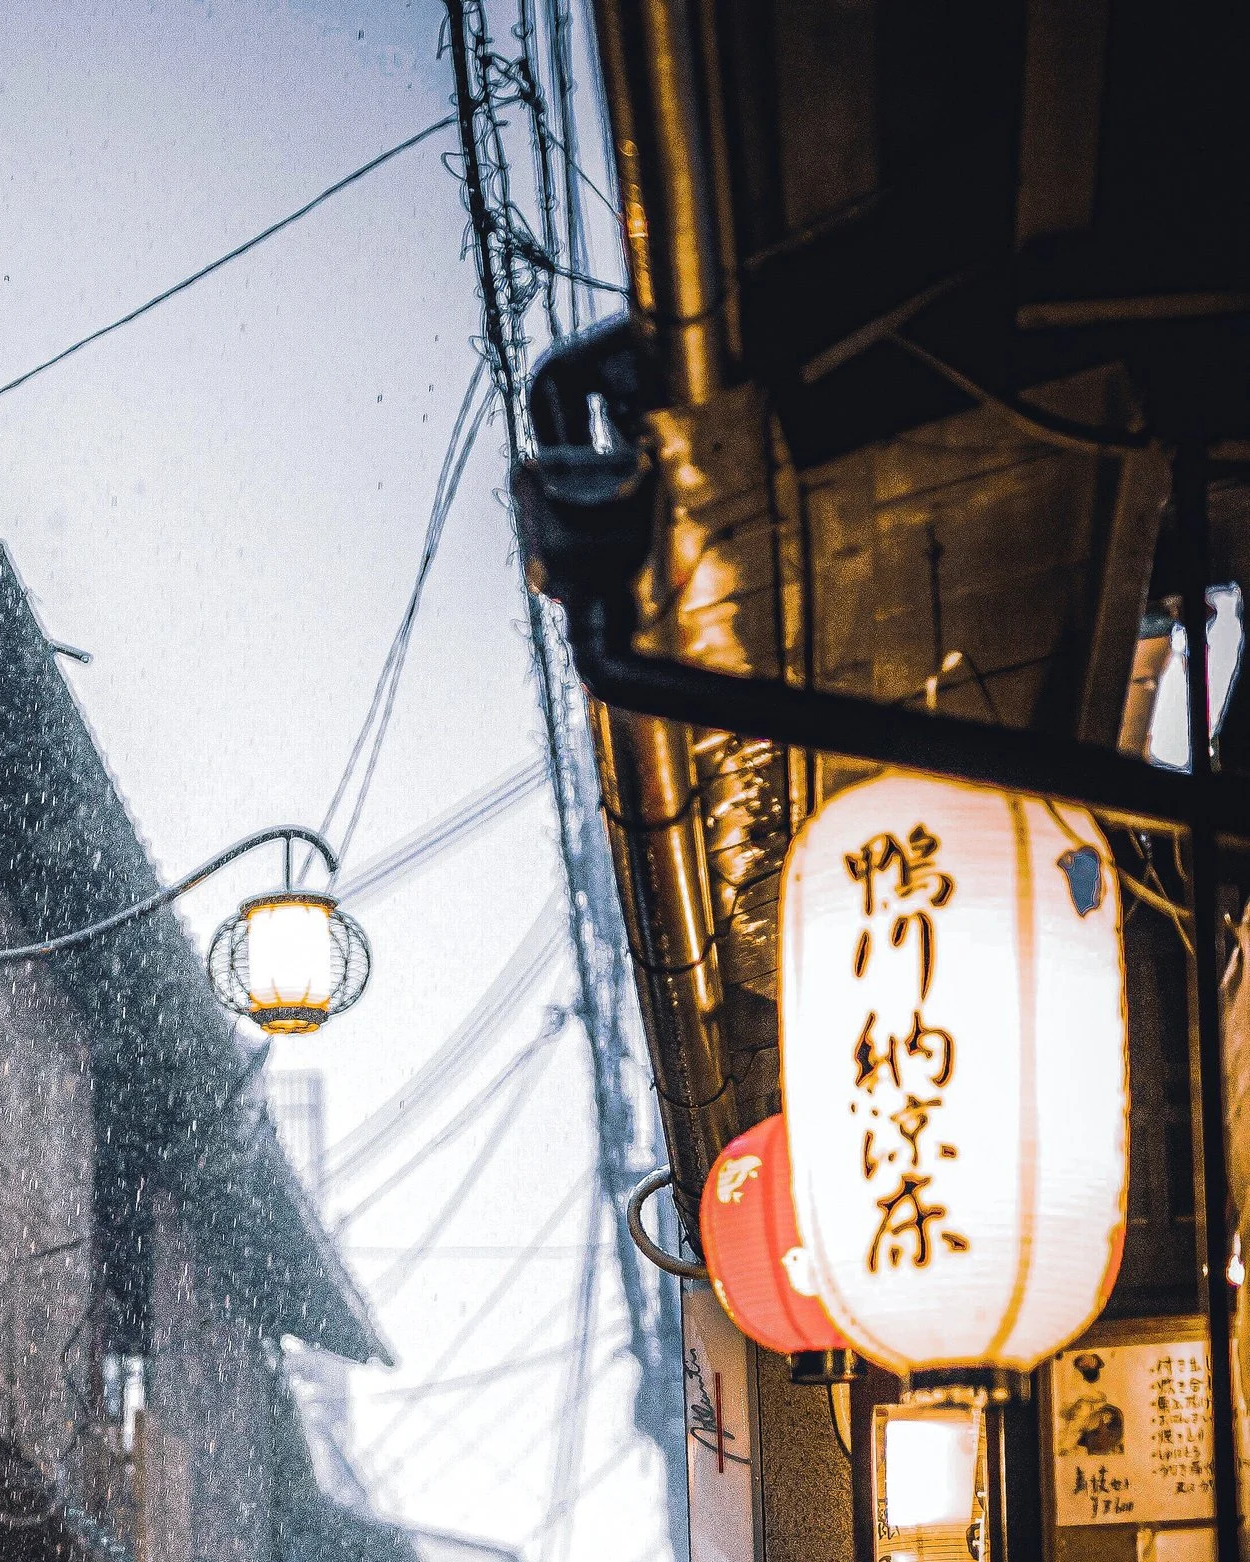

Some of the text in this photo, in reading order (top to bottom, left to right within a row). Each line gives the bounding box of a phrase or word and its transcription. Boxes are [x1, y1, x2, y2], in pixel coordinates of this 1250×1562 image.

[842, 822, 969, 1274] 鴨川納涼床
